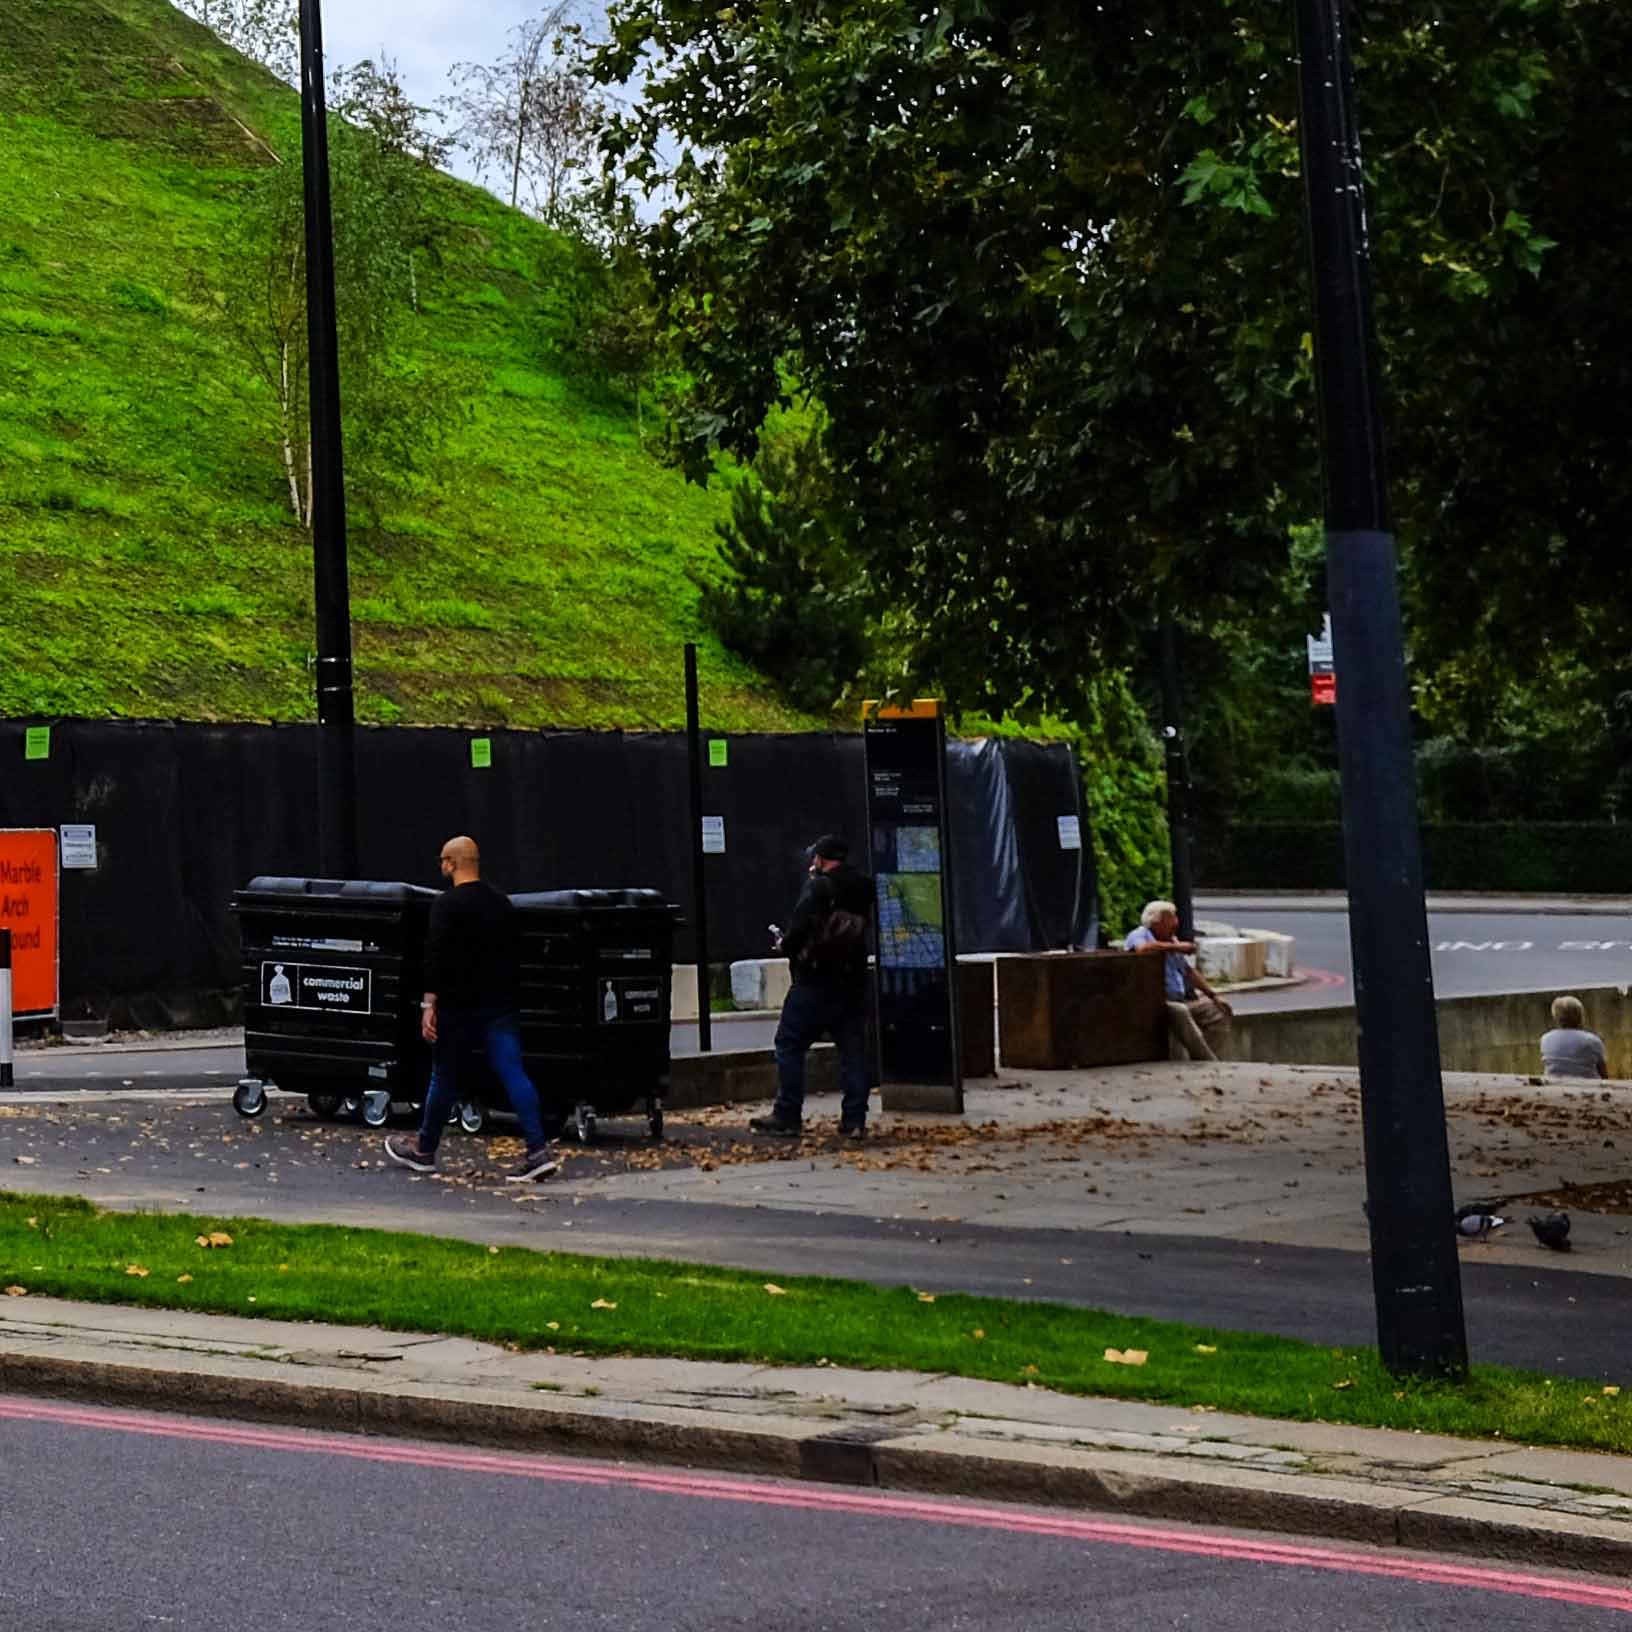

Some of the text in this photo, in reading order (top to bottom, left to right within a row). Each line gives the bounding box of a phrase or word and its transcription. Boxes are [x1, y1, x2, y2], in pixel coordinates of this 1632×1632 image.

[0, 860, 41, 884] Marble
[1, 894, 29, 918] Arch
[12, 926, 40, 950] ound
[303, 976, 364, 990] commercial
[317, 991, 350, 1003] waste
